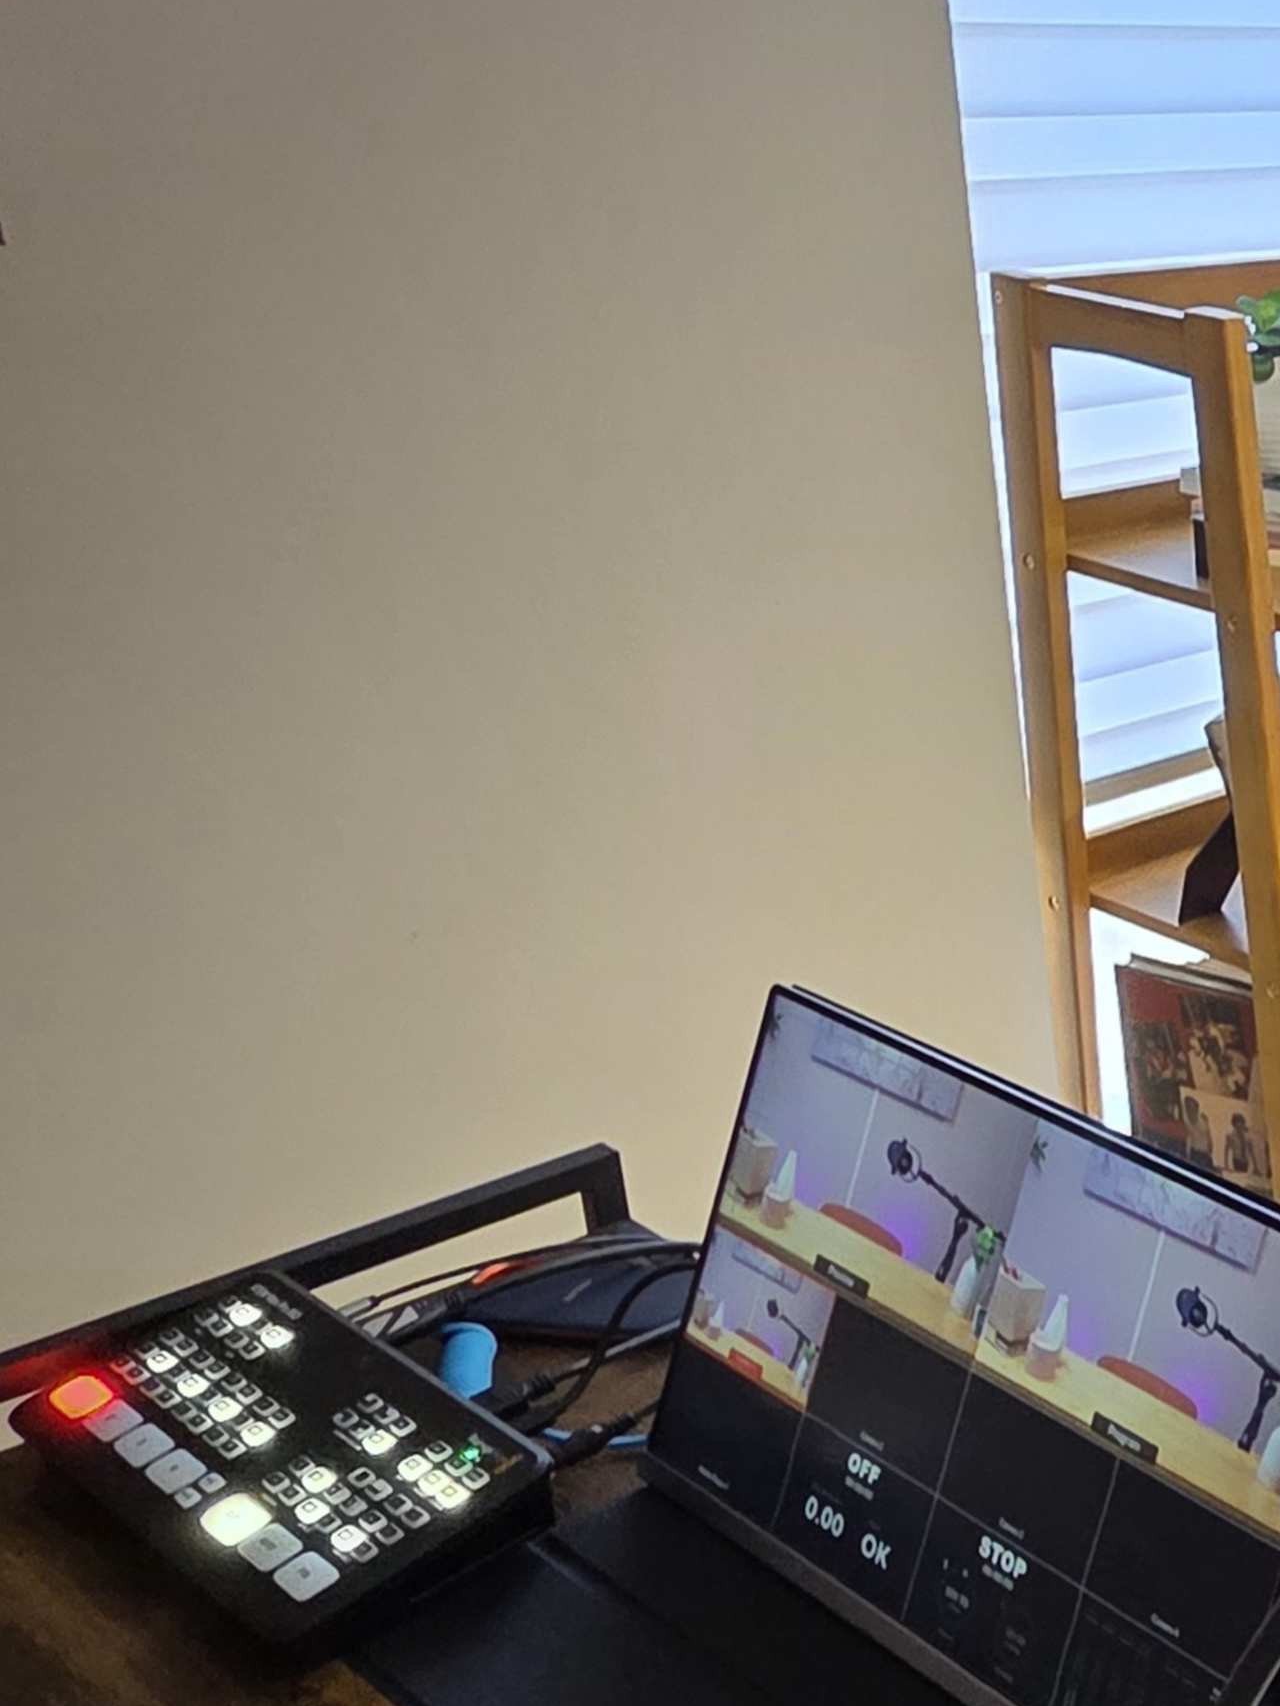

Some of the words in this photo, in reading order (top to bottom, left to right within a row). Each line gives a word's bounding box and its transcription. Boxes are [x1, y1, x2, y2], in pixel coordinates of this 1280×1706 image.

[847, 1452, 882, 1485] OFF
[804, 1494, 845, 1538] 0.00
[860, 1532, 892, 1571] OK
[978, 1535, 1028, 1580] STOP
